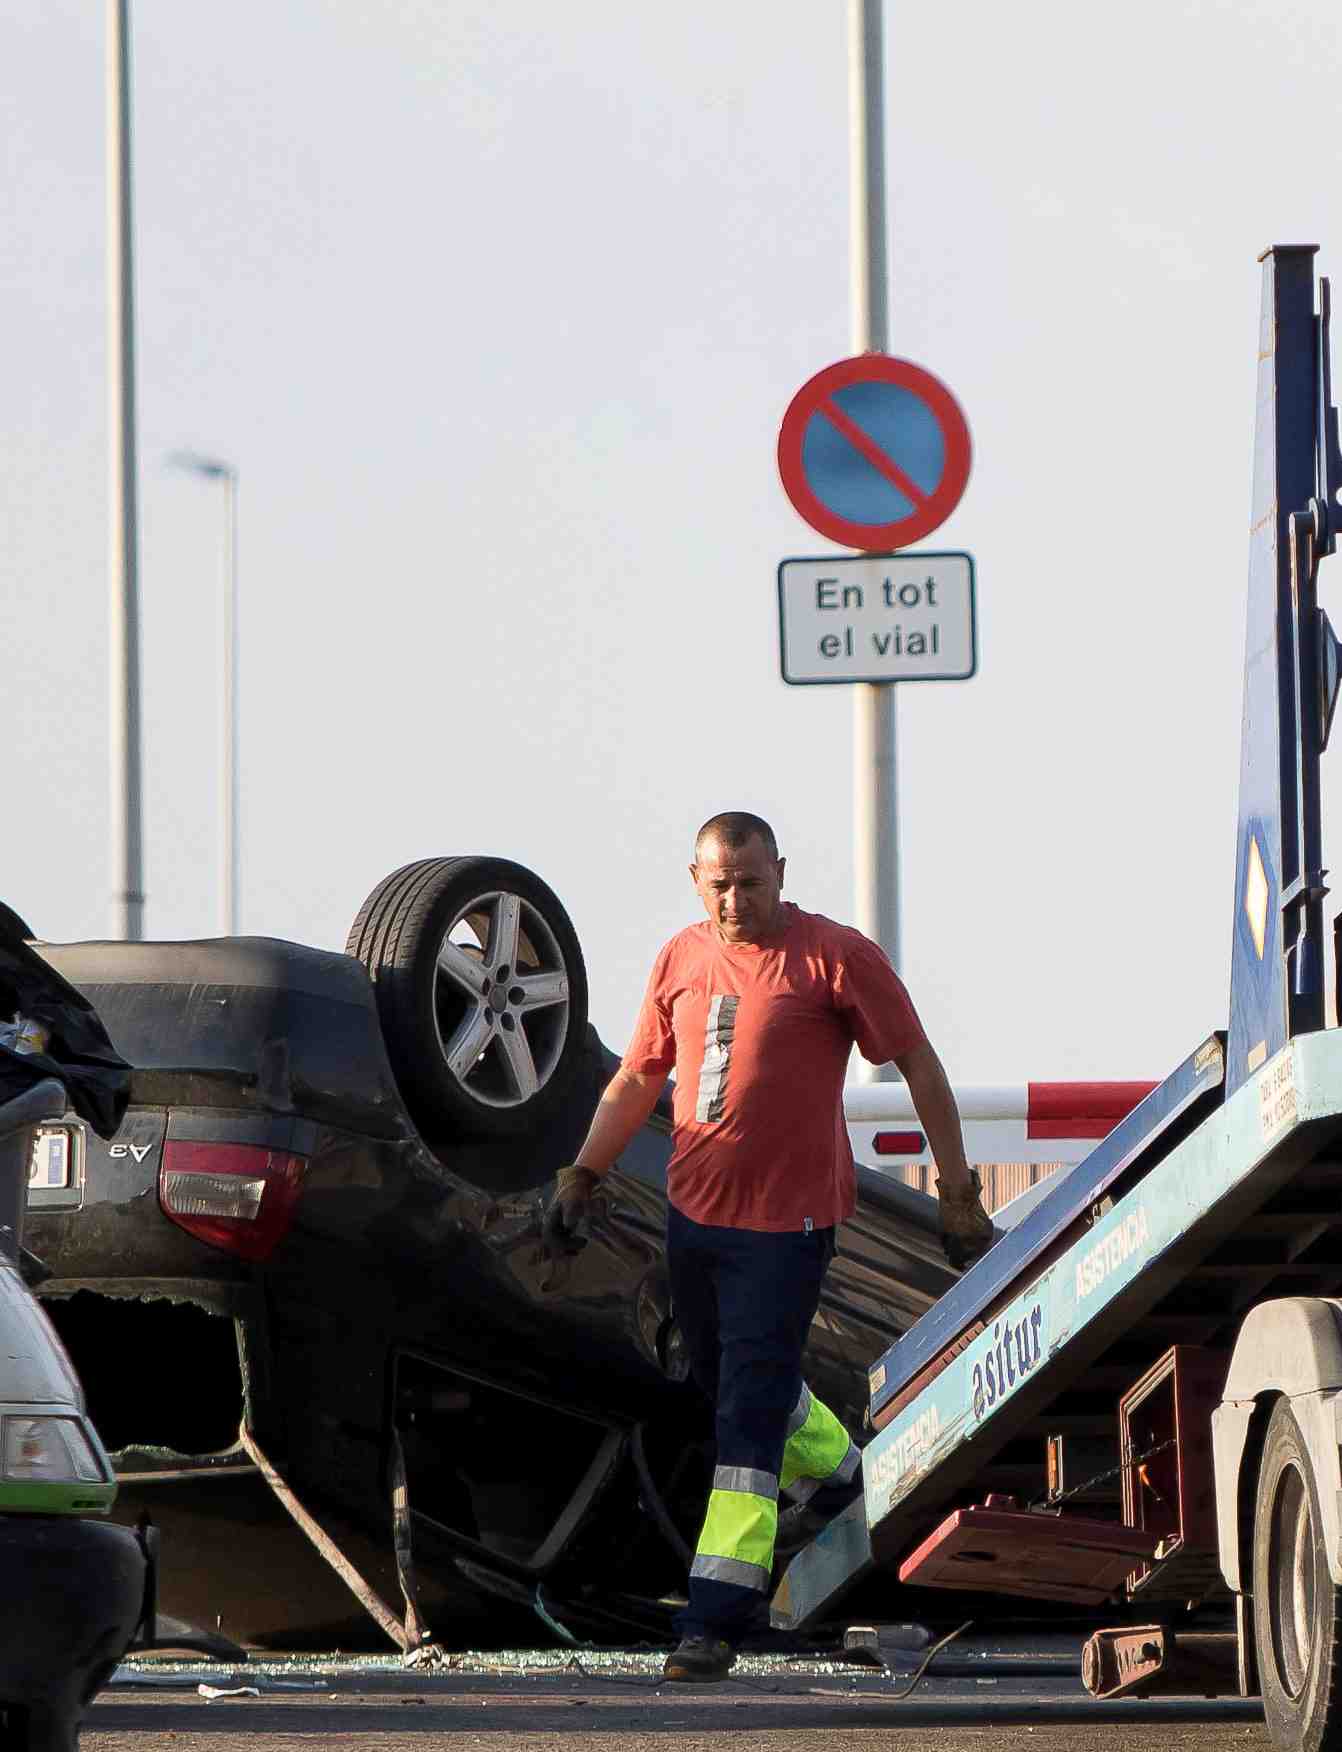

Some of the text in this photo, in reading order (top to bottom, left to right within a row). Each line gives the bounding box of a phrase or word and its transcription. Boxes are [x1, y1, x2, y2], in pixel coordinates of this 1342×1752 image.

[816, 575, 938, 609] En tot
[820, 623, 940, 658] el vial
[973, 1303, 1042, 1420] asitur
